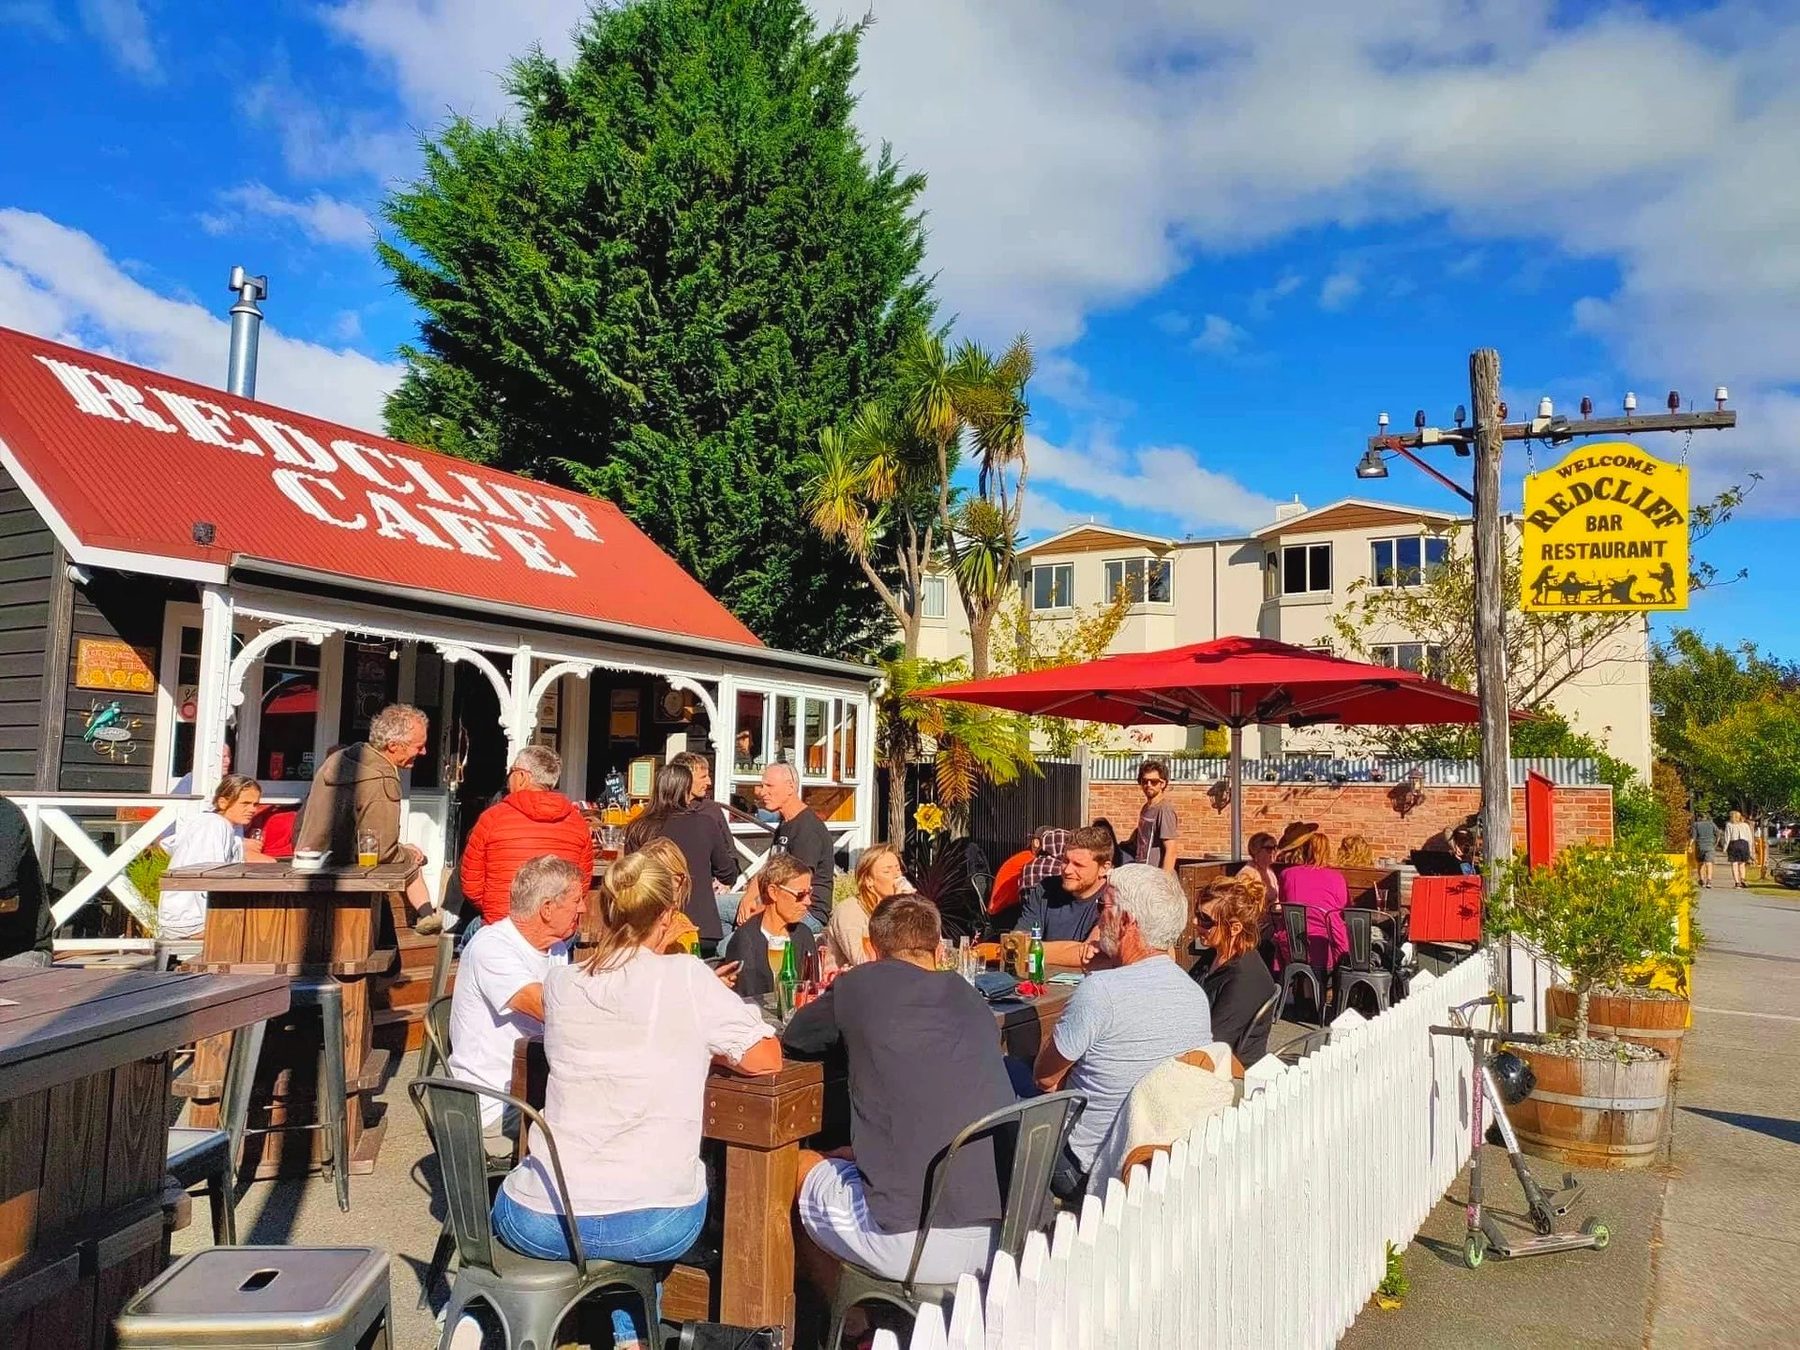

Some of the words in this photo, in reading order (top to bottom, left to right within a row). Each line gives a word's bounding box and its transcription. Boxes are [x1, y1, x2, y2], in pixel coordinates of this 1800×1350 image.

[32, 354, 605, 544] REDCLIFF
[1556, 455, 1657, 478] WELCOME
[272, 467, 577, 578] CAFE
[1527, 476, 1685, 533] REDCLIFF
[1586, 514, 1623, 532] BAR
[1541, 540, 1668, 560] RESTAURANT
